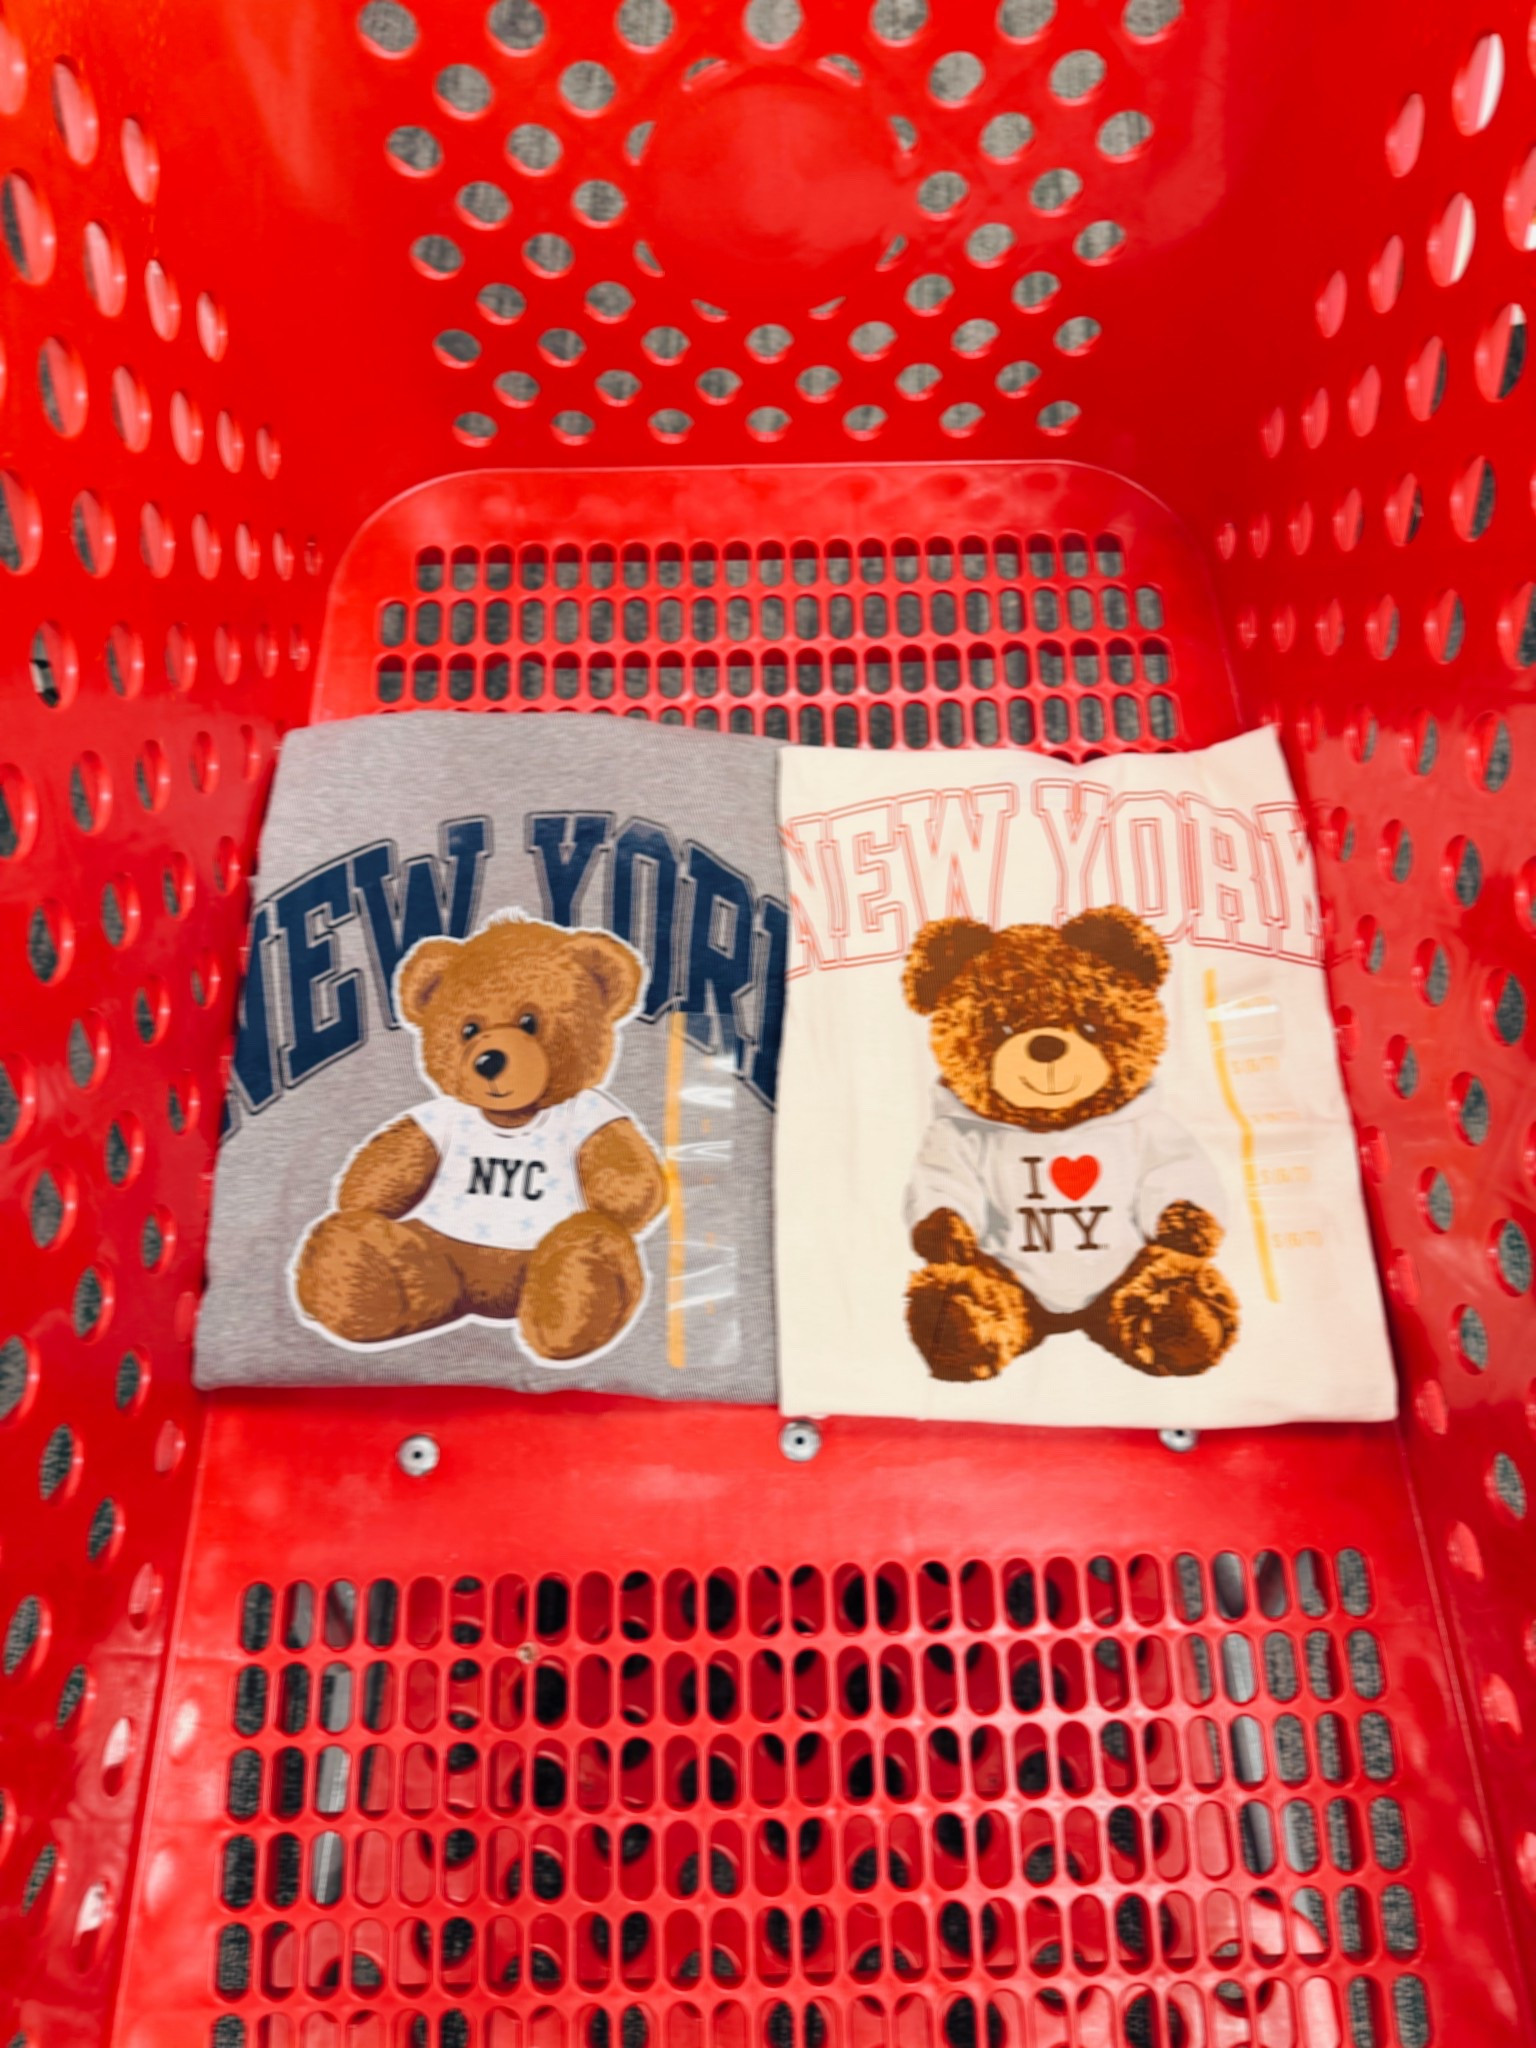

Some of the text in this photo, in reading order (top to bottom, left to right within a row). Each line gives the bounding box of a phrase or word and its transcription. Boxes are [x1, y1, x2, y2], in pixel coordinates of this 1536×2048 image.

[779, 781, 1019, 982] NEW
[466, 1156, 547, 1201] NYC
[1020, 1156, 1046, 1200] I
[1018, 1206, 1110, 1253] NY
